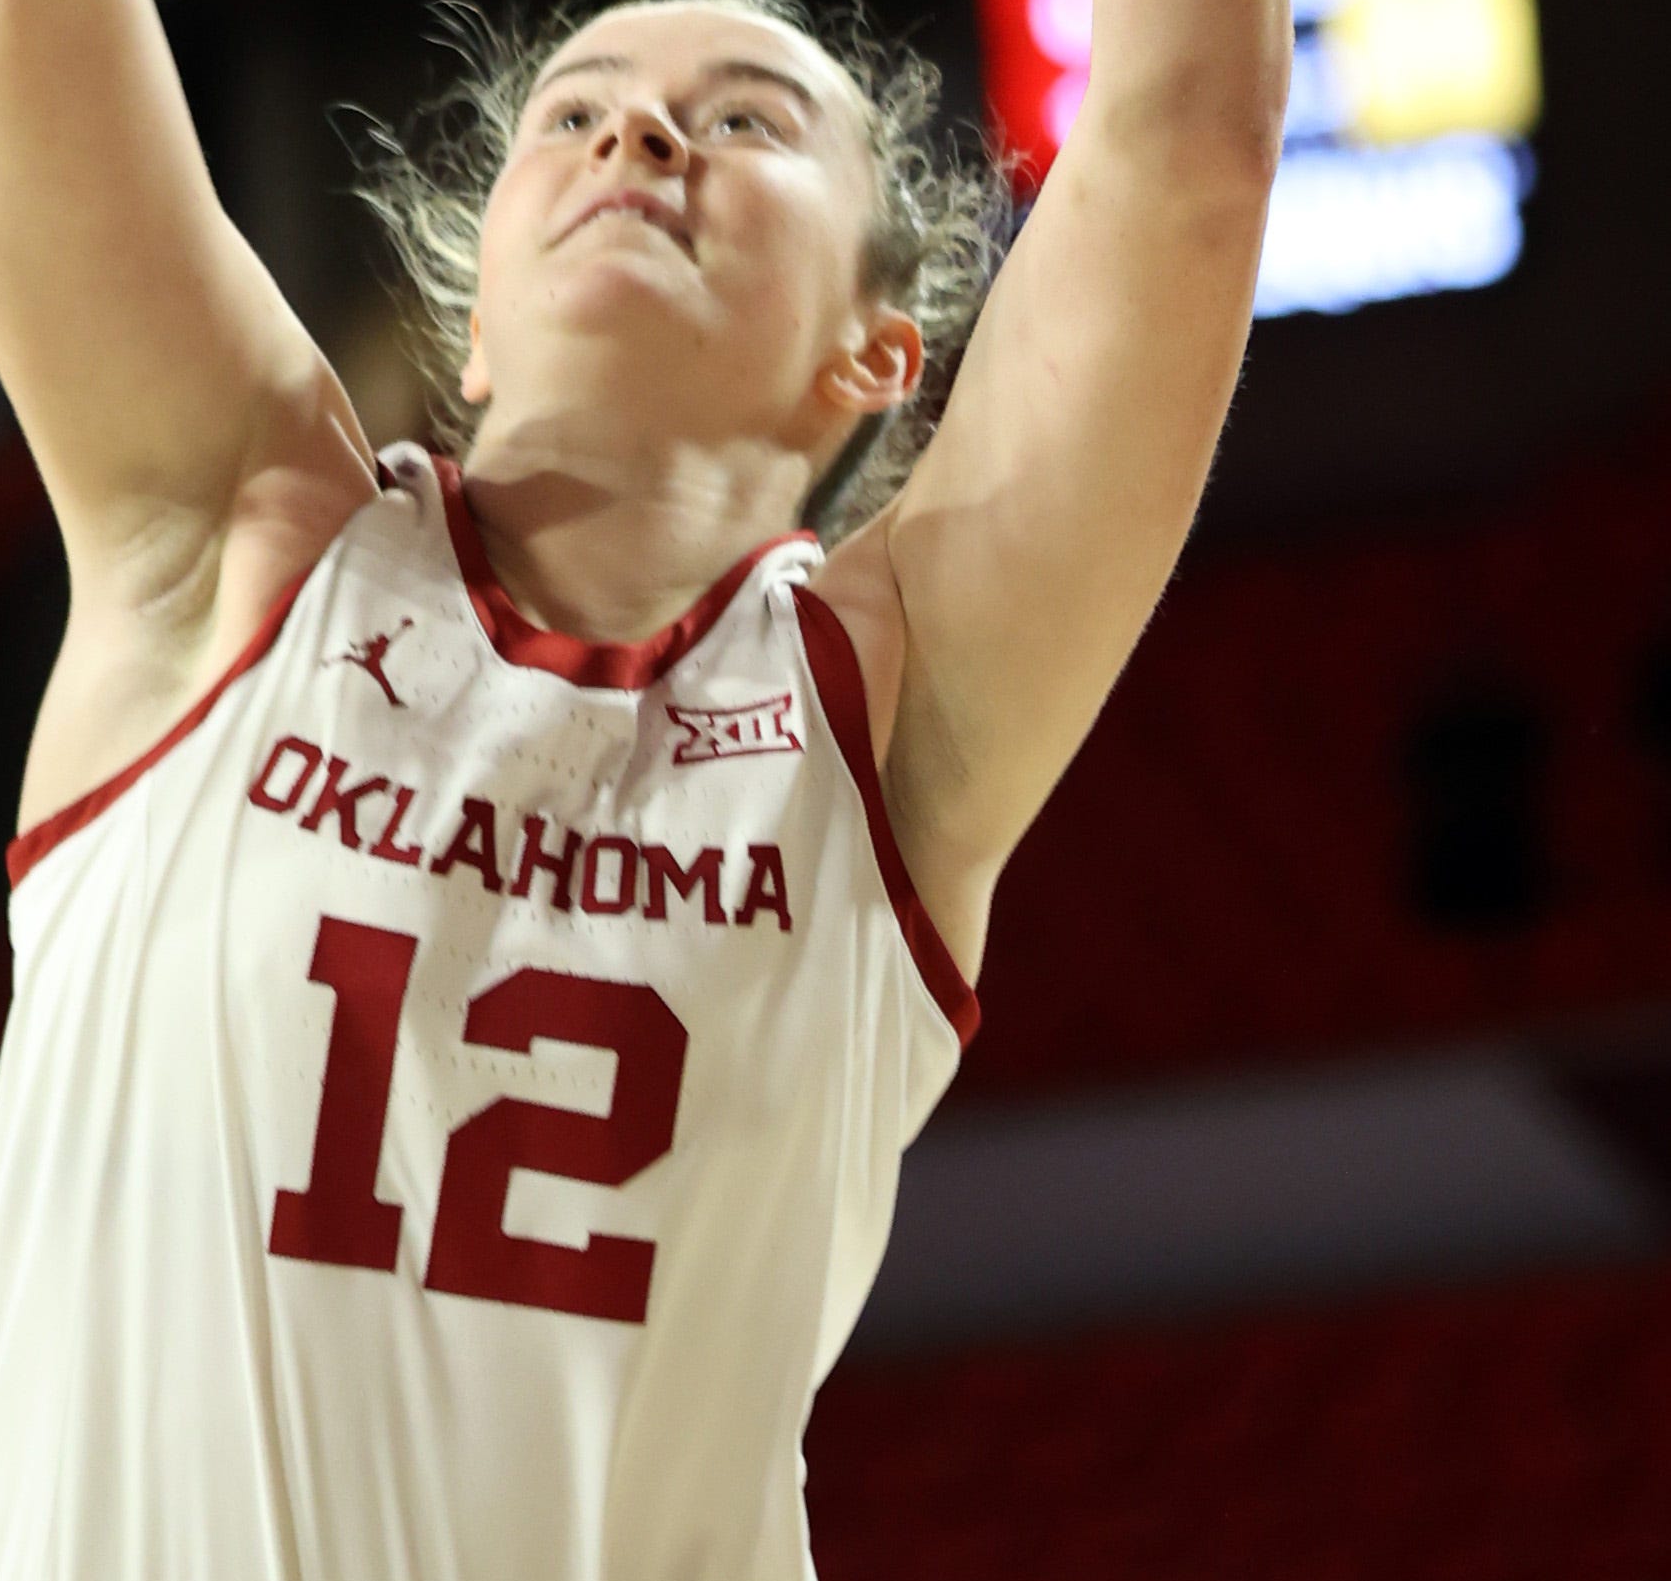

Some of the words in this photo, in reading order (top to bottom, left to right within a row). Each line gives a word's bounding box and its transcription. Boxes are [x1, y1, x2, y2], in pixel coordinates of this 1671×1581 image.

[666, 693, 804, 766] XII
[248, 735, 792, 932] OKLAHOMA
[268, 914, 690, 1324] 12
